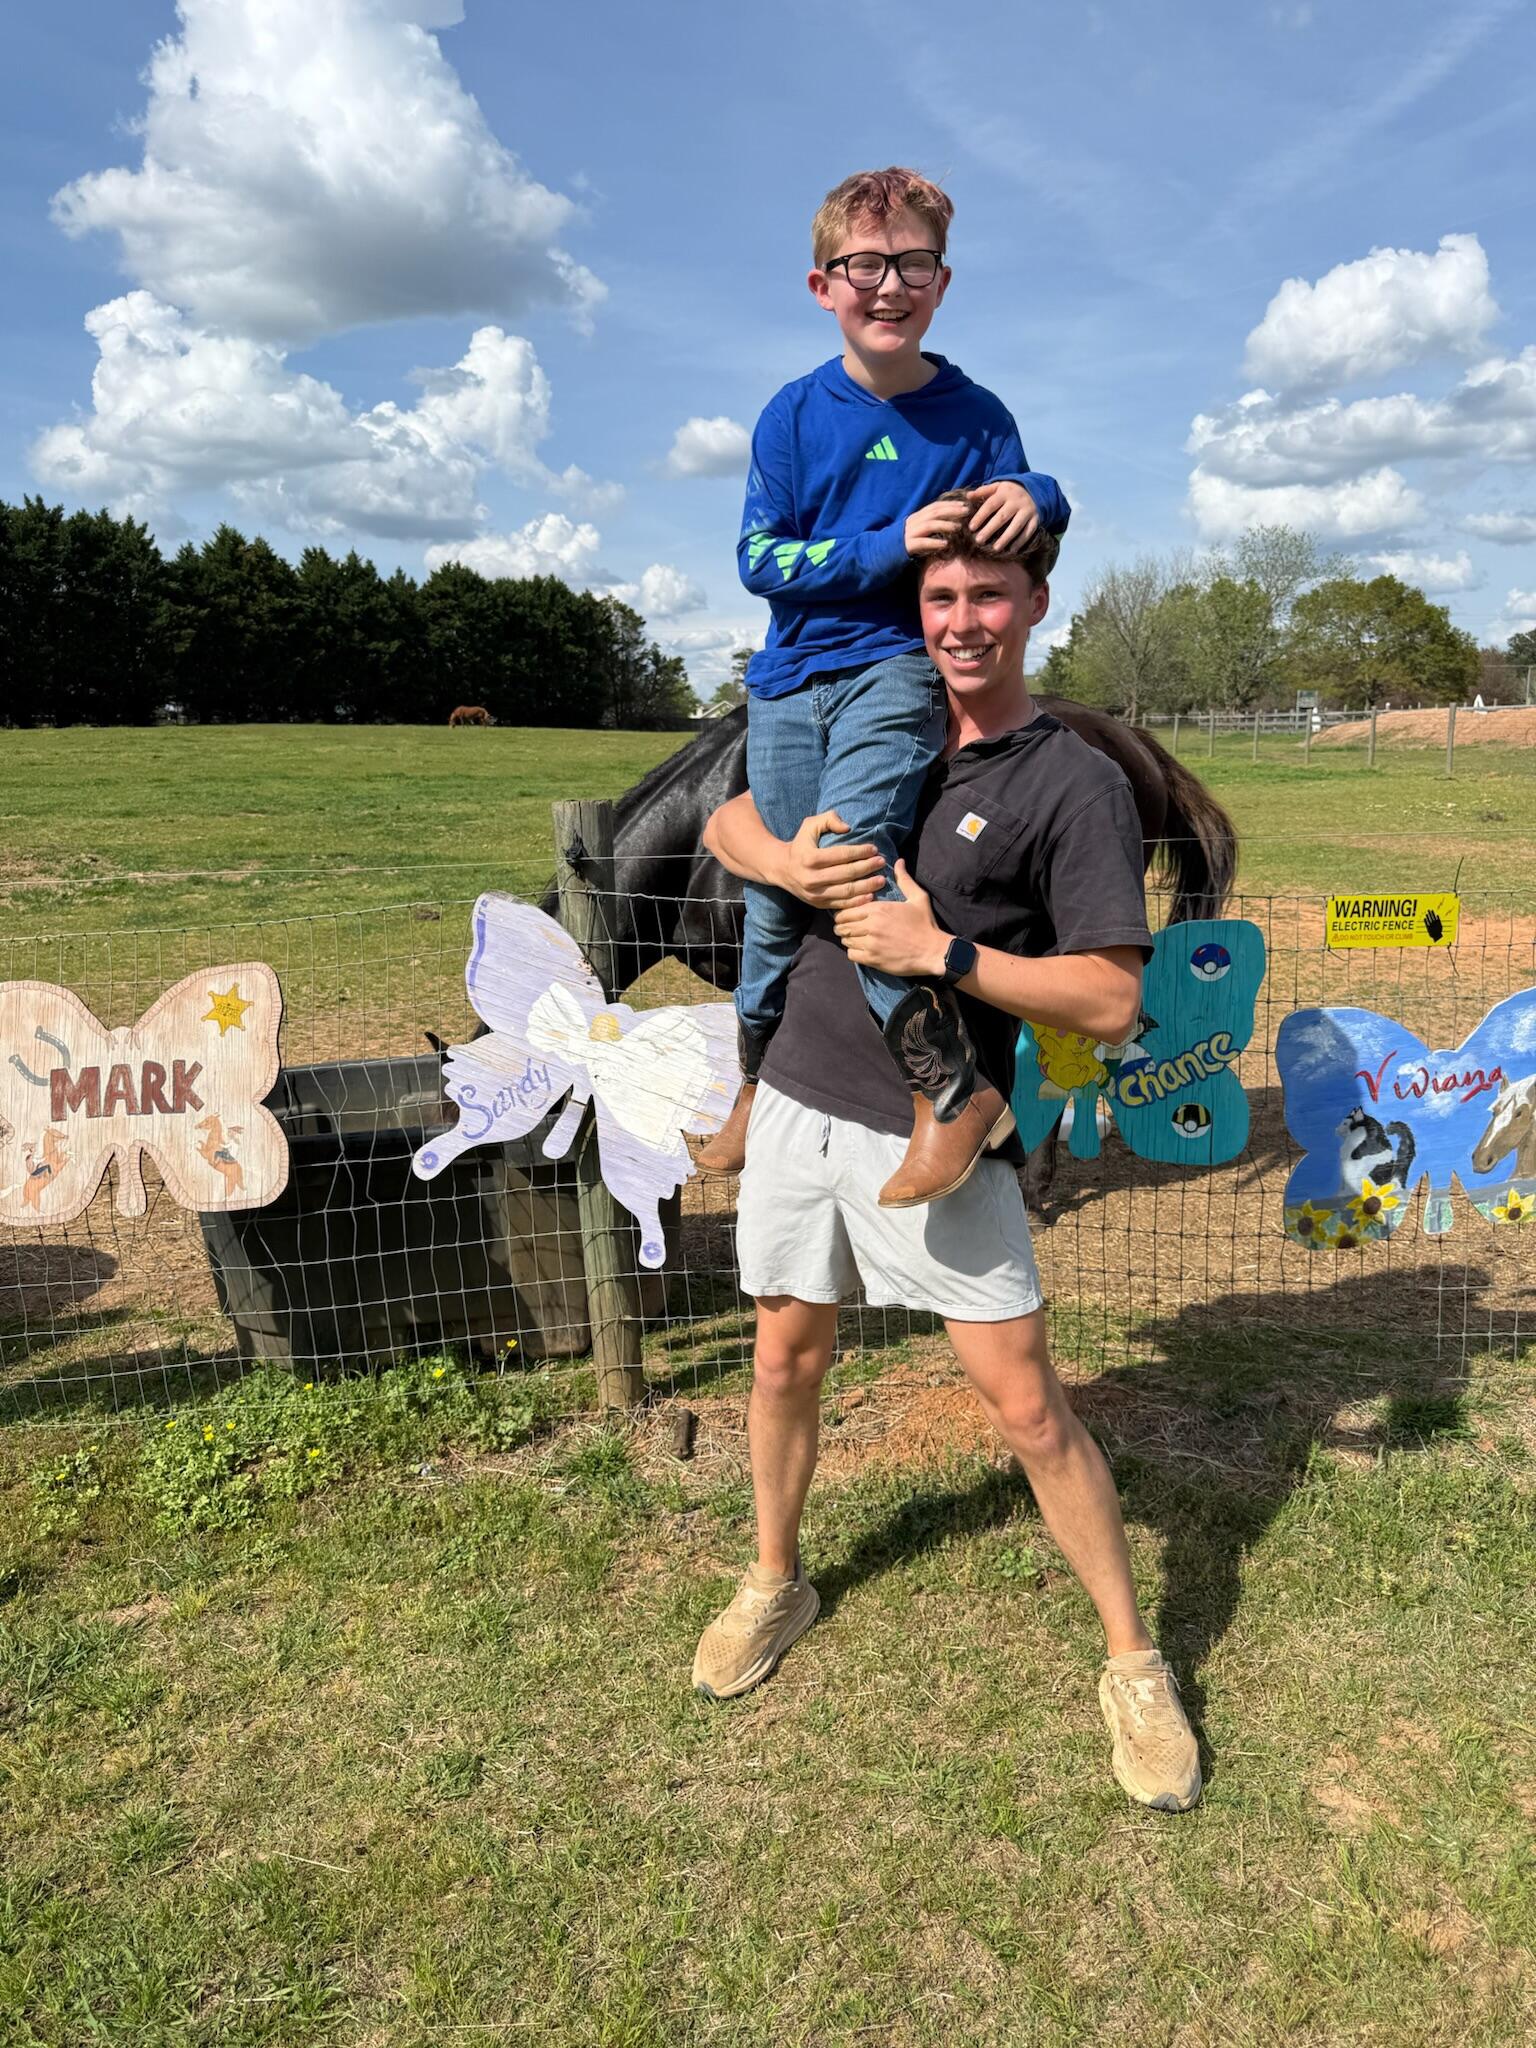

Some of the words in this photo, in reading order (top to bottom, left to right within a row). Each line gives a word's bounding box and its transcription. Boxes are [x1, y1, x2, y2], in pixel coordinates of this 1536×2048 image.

[1332, 921, 1380, 932] ELECTRIC
[1382, 920, 1415, 930] FENCE
[1335, 899, 1418, 918] WARNING!
[50, 1059, 205, 1122] MARK
[457, 1057, 552, 1140] Sandy
